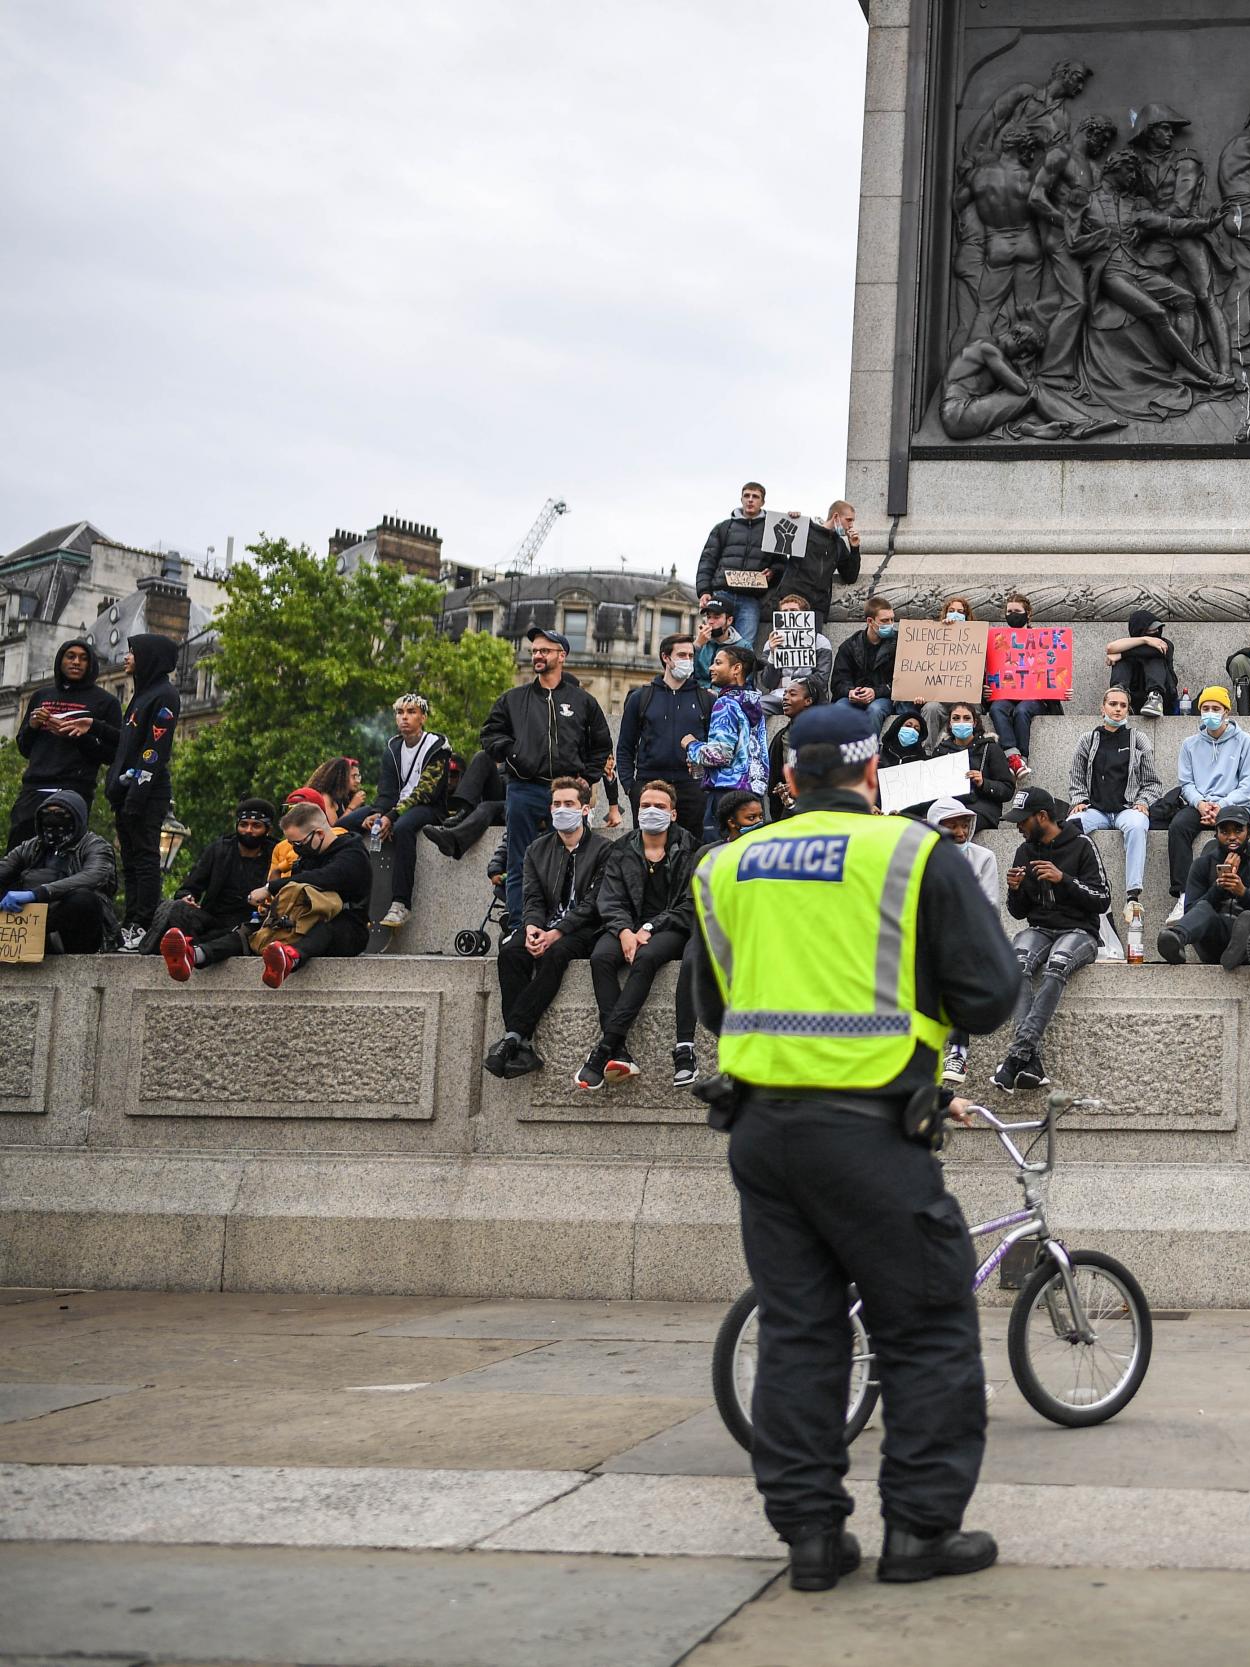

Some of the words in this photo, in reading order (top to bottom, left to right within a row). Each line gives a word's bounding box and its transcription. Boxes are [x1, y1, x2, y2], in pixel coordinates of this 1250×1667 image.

[775, 612, 811, 627] BLACK
[905, 626, 952, 642] SILENCE
[959, 627, 971, 641] IS
[994, 629, 1068, 650] BLACK
[926, 642, 984, 656] BETRAYAL
[775, 650, 815, 667] MATTER
[900, 659, 935, 672] BLACK
[939, 660, 968, 672] LIVES
[924, 674, 972, 688] MATTER
[986, 667, 1069, 689] MATTER
[740, 839, 844, 872] POLICE
[6, 912, 40, 926] DON'T
